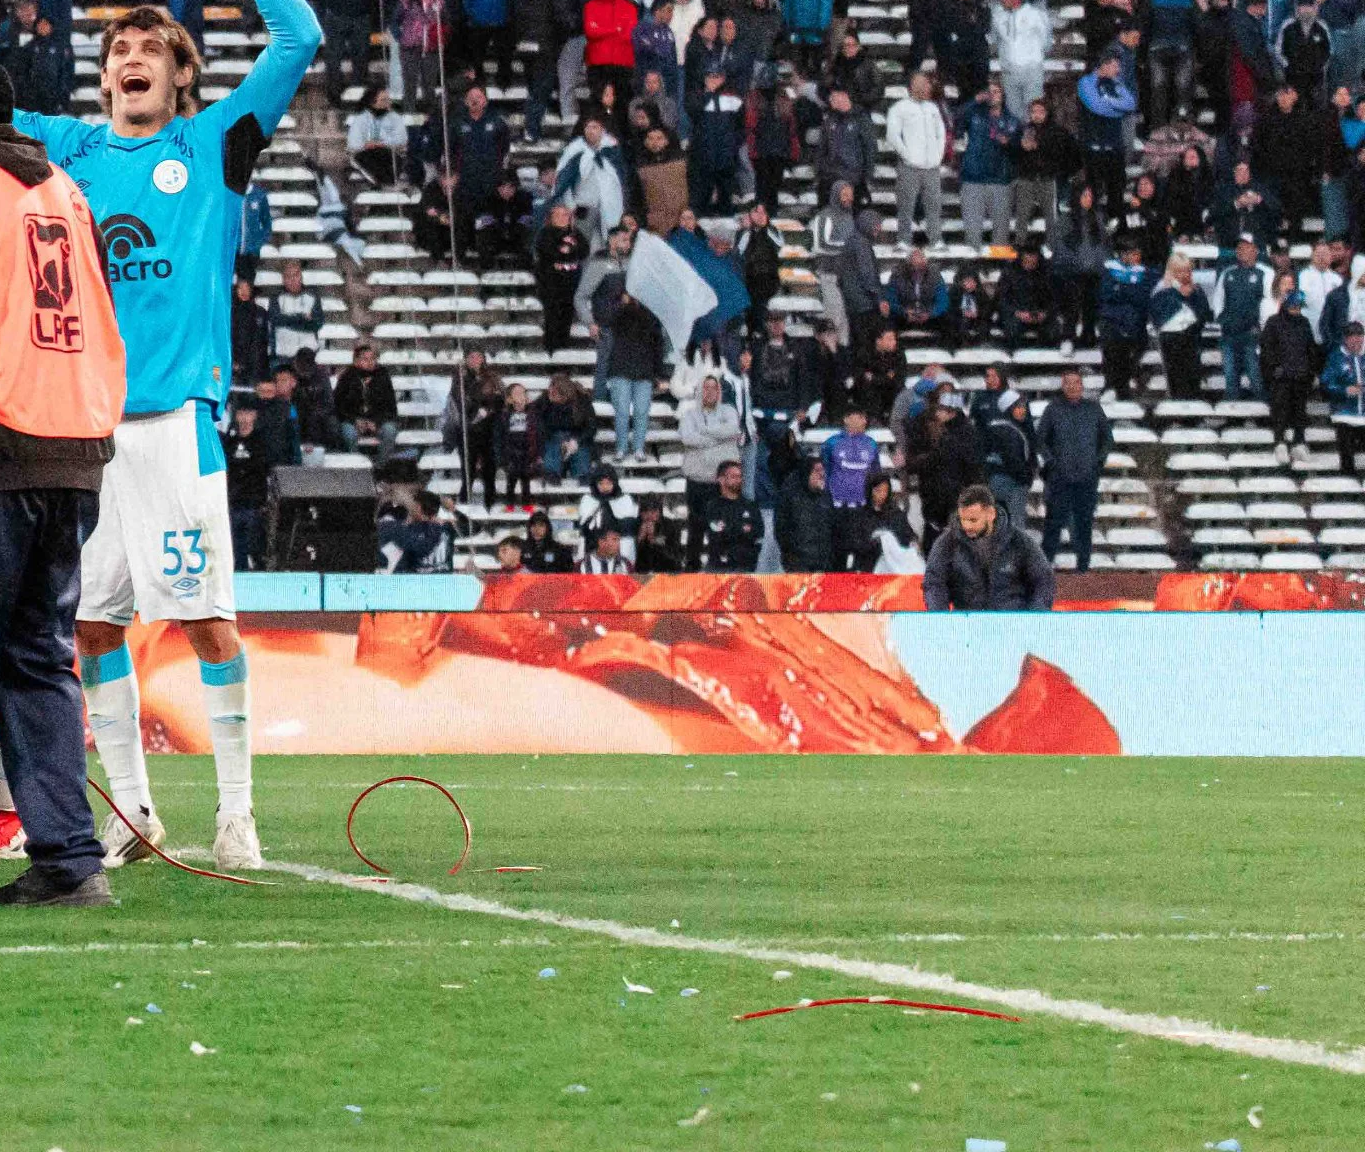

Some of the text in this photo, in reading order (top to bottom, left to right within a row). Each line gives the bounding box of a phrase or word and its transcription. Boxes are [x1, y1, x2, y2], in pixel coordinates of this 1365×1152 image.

[110, 259, 173, 283] acro
[36, 313, 81, 346] LPF
[163, 529, 206, 576] 53
